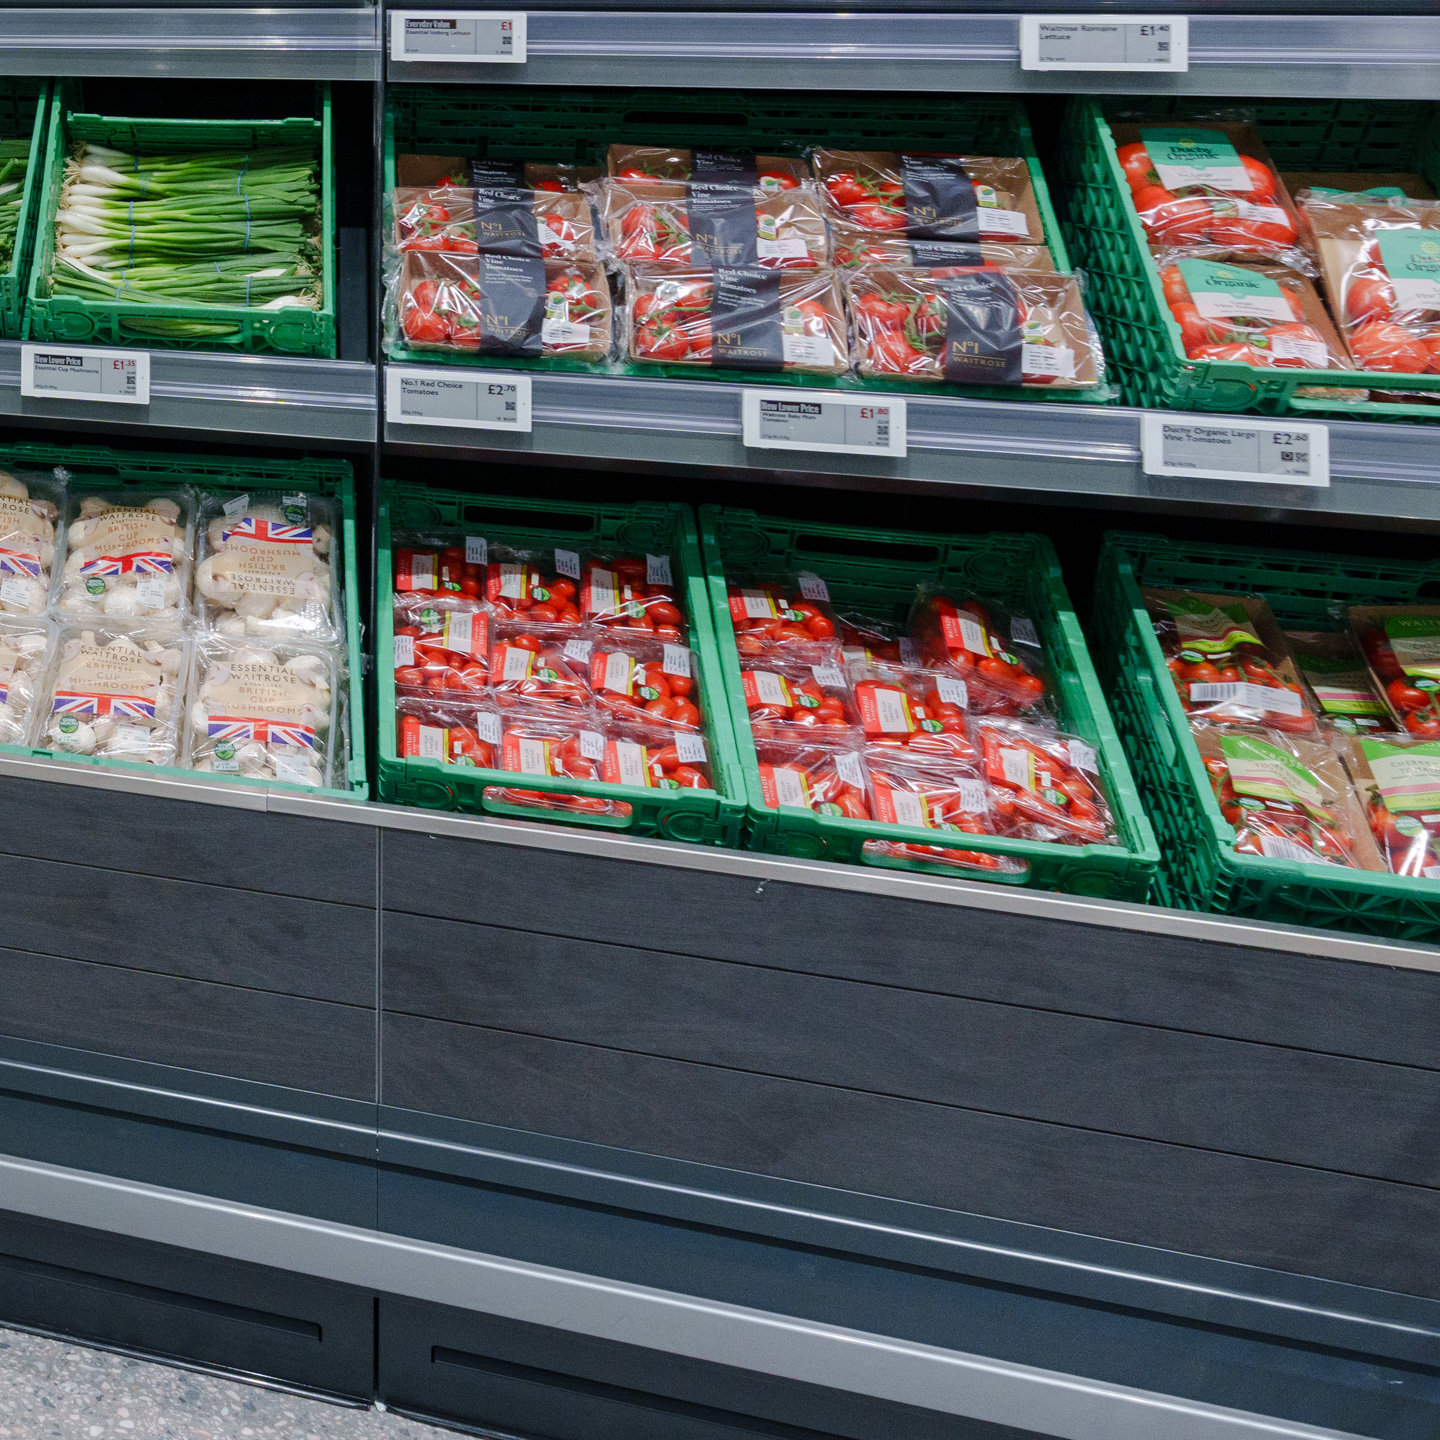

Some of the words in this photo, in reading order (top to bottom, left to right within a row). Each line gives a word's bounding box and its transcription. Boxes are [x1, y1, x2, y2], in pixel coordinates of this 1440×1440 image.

[405, 20, 430, 29] Everyday
[430, 20, 451, 29] Value
[501, 21, 513, 31] £1
[1040, 24, 1077, 32] Waitrose
[1081, 24, 1118, 32] Romaine
[1140, 25, 1169, 36] £1.40
[1040, 32, 1071, 41] Lettuce
[690, 183, 707, 191] Red
[710, 184, 739, 193] Choice
[478, 188, 491, 198] Red
[495, 191, 521, 201] Choice
[485, 253, 499, 261] Red
[502, 254, 531, 264] Choice
[484, 264, 524, 273] Tomatoes
[718, 267, 732, 275] Red
[737, 269, 767, 280] Choice
[718, 273, 738, 282] Vine
[719, 281, 757, 294] Tomatoes
[960, 282, 995, 293] Choice
[1206, 279, 1260, 290] Organic
[719, 347, 769, 358] WAITROSE
[35, 355, 47, 363] New
[48, 356, 66, 365] Lower
[67, 357, 82, 366] Price
[113, 360, 136, 370] £1.35
[952, 356, 1006, 368] WAITROSE
[401, 388, 439, 396] Tomatoes
[420, 380, 434, 388] Red
[436, 381, 463, 390] Choice
[487, 384, 516, 396] £2.70
[760, 401, 777, 411] New
[778, 402, 799, 413] Lower
[800, 404, 819, 414] Price
[860, 408, 889, 419] £1.80
[1162, 425, 1191, 434] Duchy
[1193, 427, 1228, 437] Organic
[1230, 430, 1256, 439] Large
[1162, 433, 1185, 441] Vine
[1186, 435, 1232, 445] Tomatoes
[100, 506, 157, 516] ESSENTIAL
[99, 512, 156, 522] WAITROSE
[107, 523, 147, 534] BRITISH
[118, 531, 138, 542] CUP
[94, 538, 161, 551] MUSHROOMS
[224, 544, 300, 556] MUSHROOMS
[239, 562, 286, 571] BRITISH
[230, 573, 295, 586] WAITROSE
[233, 582, 295, 594] ESSENTIAL
[80, 649, 143, 664] WAITROSE
[86, 661, 132, 672] BRITISH
[231, 663, 296, 676] ESSENTIAL
[97, 671, 120, 681] CUP
[230, 673, 296, 684] WAITROSE
[69, 677, 145, 691] MUSHROOMS
[239, 686, 287, 697] BRITISH
